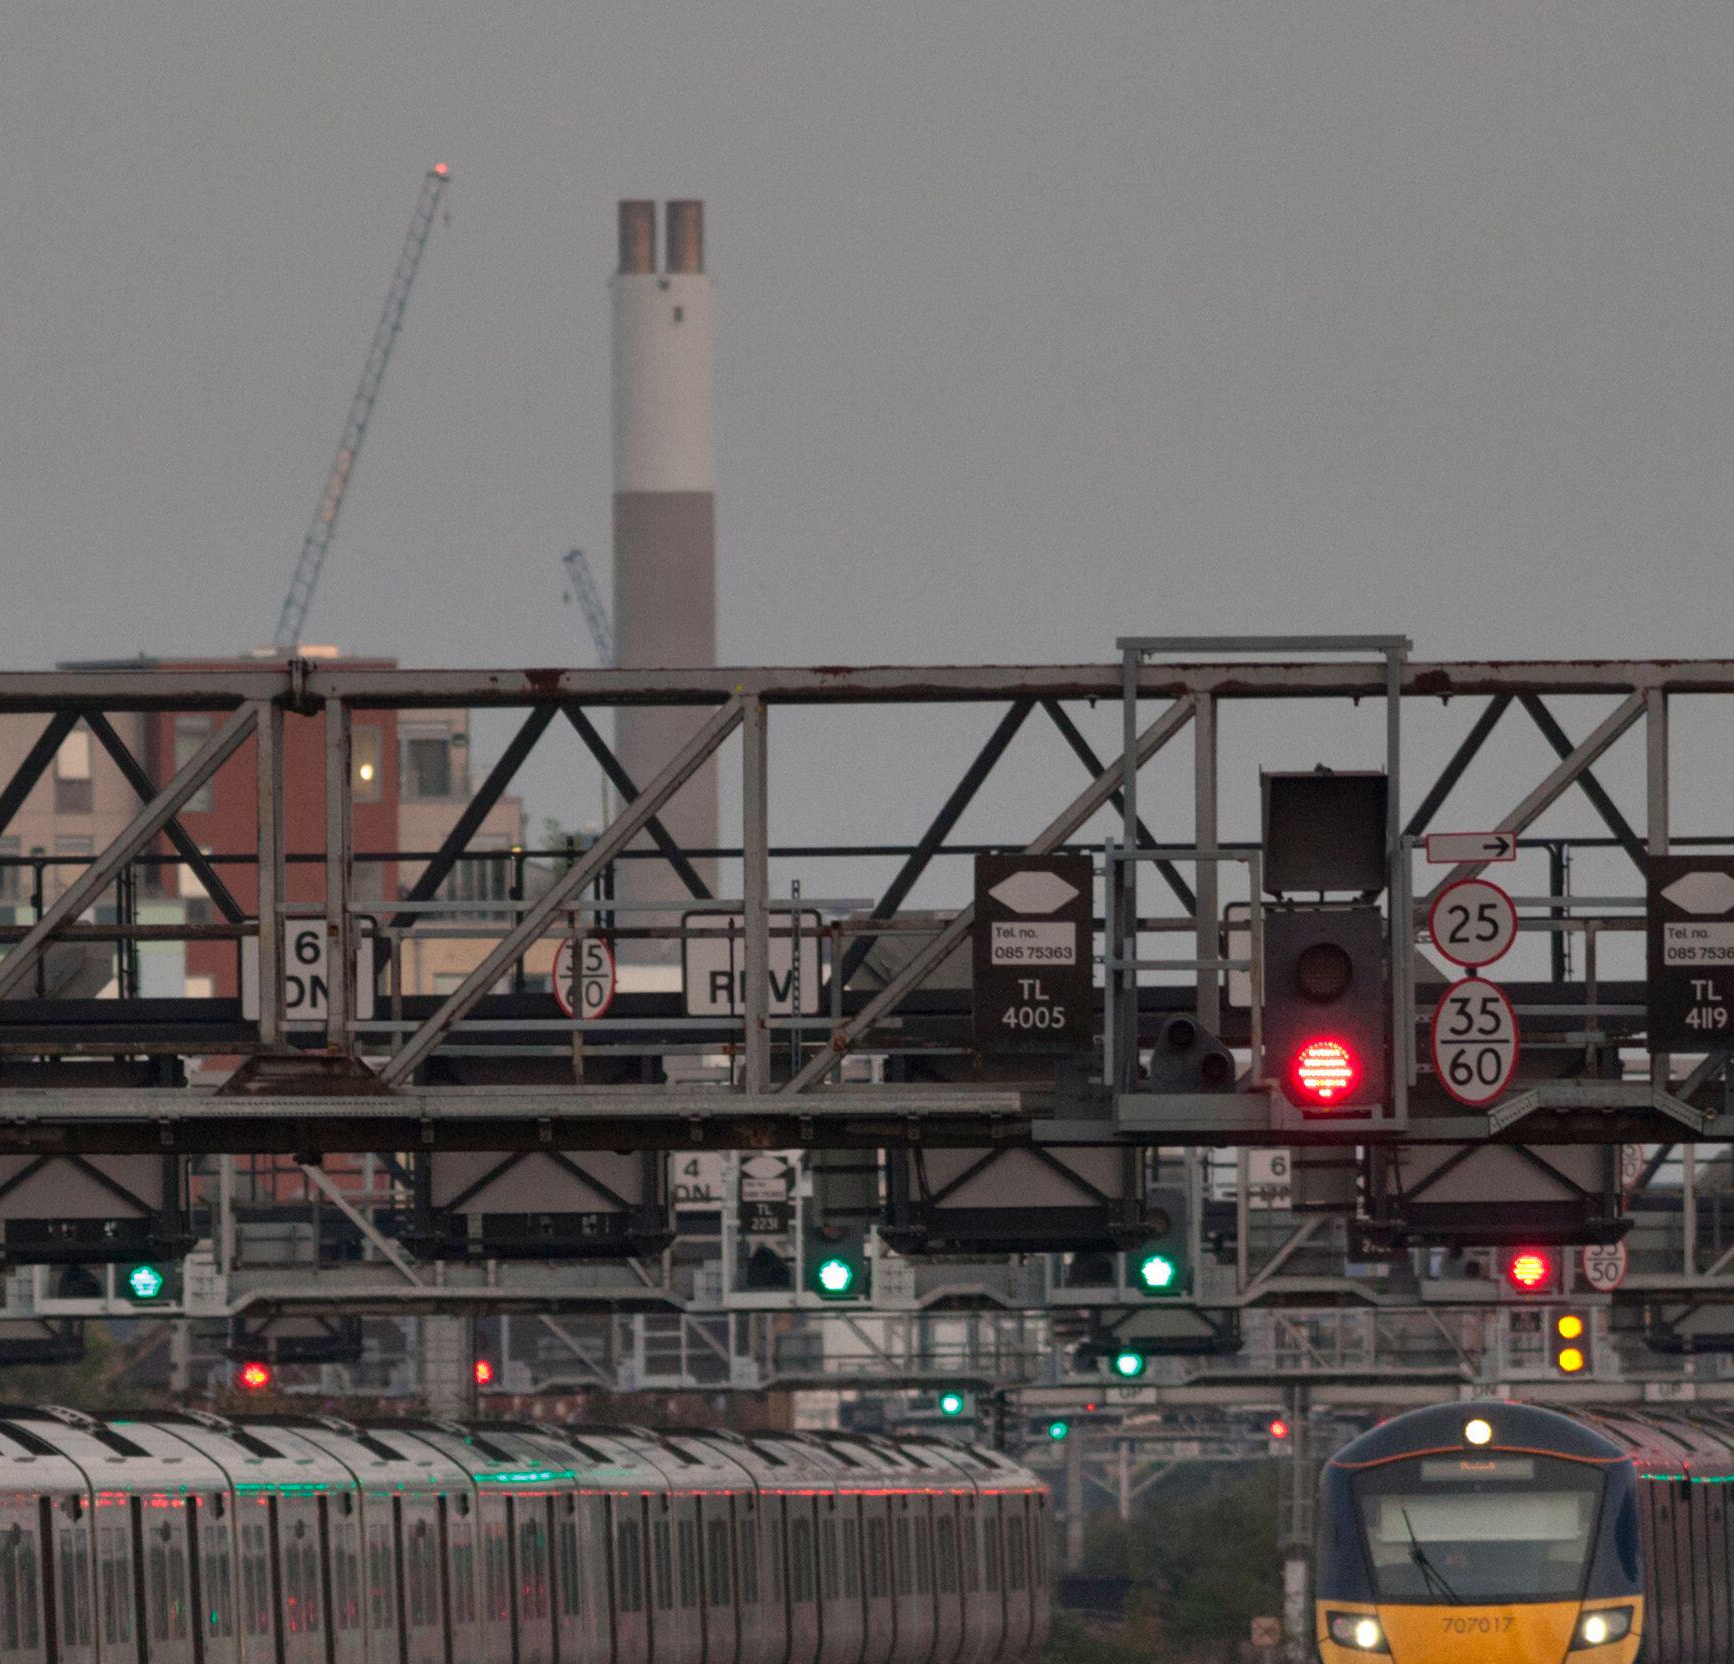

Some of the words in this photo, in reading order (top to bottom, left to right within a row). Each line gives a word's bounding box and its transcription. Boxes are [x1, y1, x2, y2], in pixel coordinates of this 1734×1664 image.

[995, 927, 1016, 938] Tel.
[1019, 929, 1037, 938] no.
[1448, 903, 1499, 943] 25
[295, 931, 320, 965] 6
[995, 947, 1023, 959] 085
[1027, 947, 1072, 959] 75363
[1668, 947, 1696, 959] 085
[710, 970, 793, 1003] RV
[1017, 979, 1050, 1000] TL
[1690, 980, 1722, 1000] TL
[1002, 1006, 1065, 1029] 4005
[1449, 997, 1501, 1035] 35
[1685, 1007, 1728, 1029] 4119
[1449, 1048, 1501, 1085] 60
[683, 1158, 699, 1178] 4
[1271, 1156, 1286, 1176] 6
[756, 1204, 774, 1216] TL
[1592, 1262, 1617, 1282] 50
[1443, 1616, 1515, 1633] 707017
